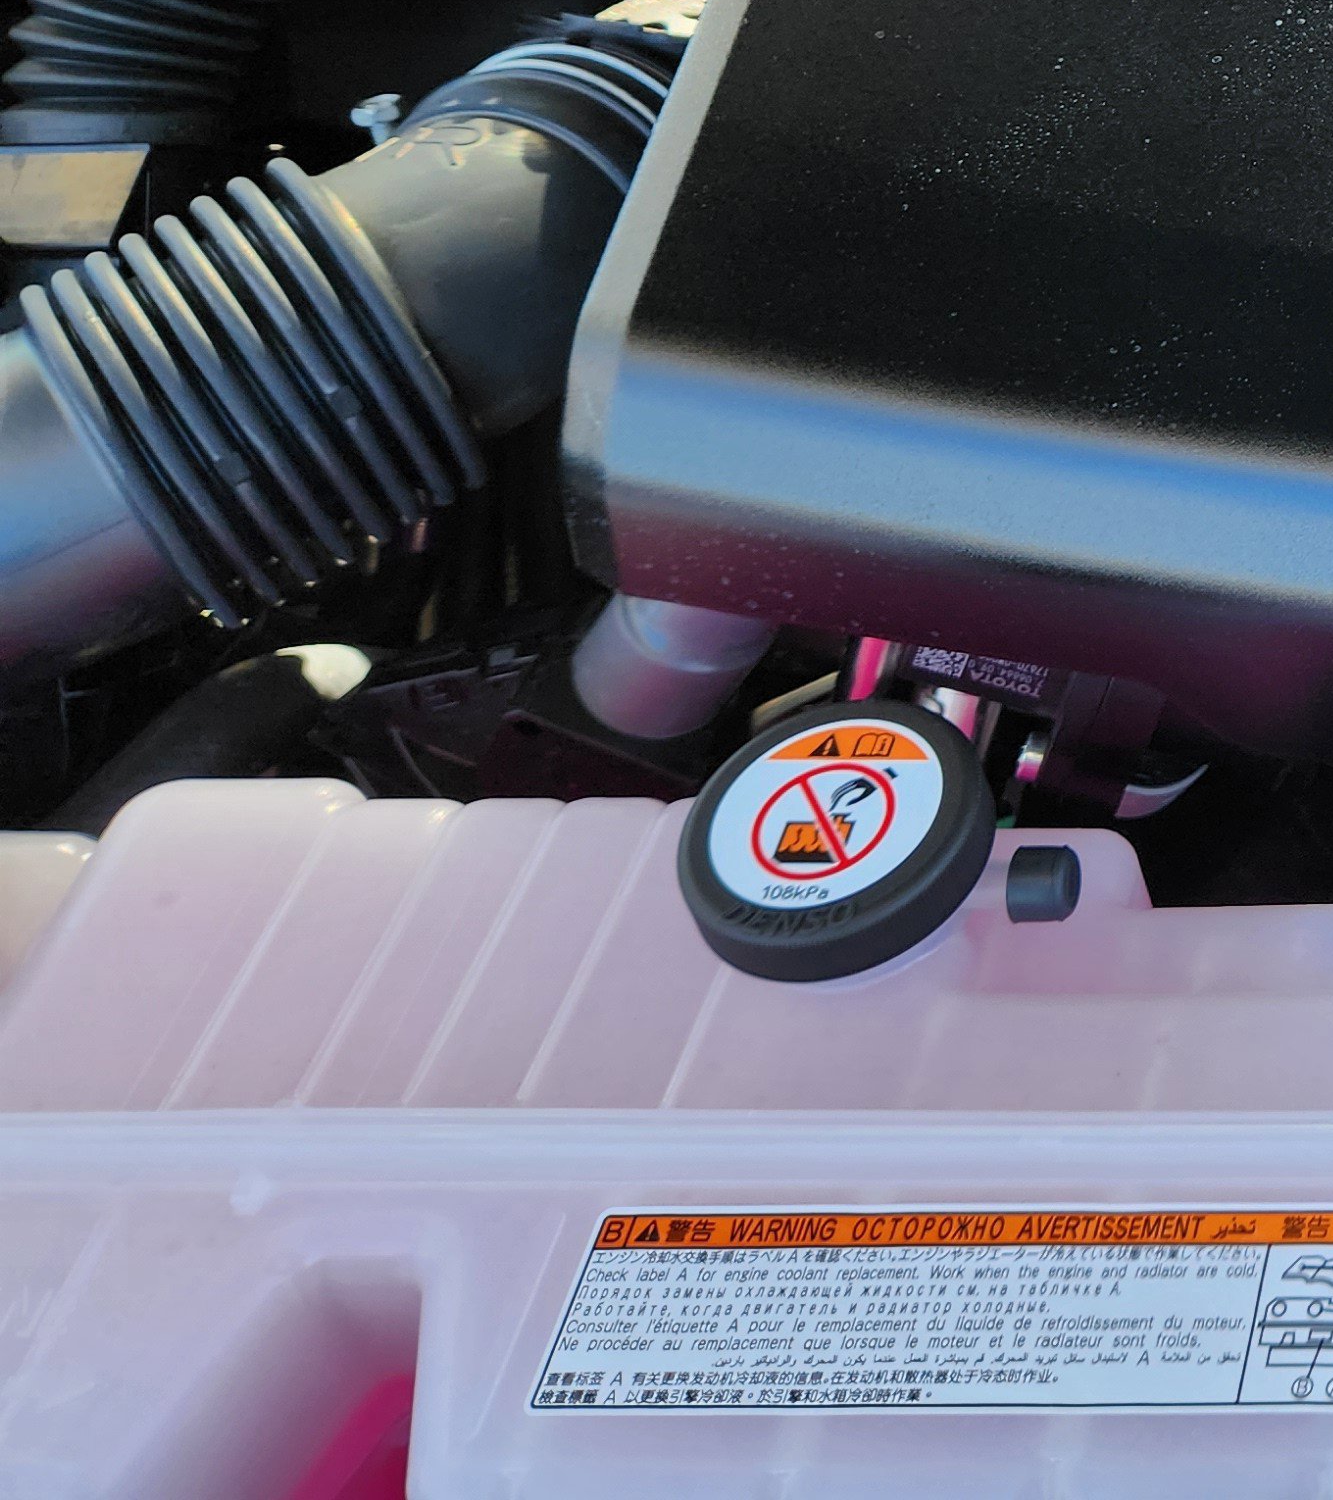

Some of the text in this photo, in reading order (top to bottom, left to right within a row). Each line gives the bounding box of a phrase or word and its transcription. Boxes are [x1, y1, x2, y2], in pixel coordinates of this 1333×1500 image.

[969, 669, 1041, 698] TOYOTA
[761, 884, 830, 900] 108kPa
[719, 900, 860, 937] DENSO
[602, 1220, 625, 1243] B
[665, 1219, 715, 1242] 警告
[729, 1218, 838, 1242] WARNING
[852, 1216, 1005, 1241] ОСТОРОЖНО
[1016, 1215, 1206, 1240] AVERTISSEMENT
[1210, 1218, 1256, 1240] تحذير
[1282, 1216, 1330, 1239] 警告
[586, 1263, 1258, 1284] Check label A for engine coolant replacement. Work when the engine and radiator are cold.
[579, 1285, 653, 1300] Порядок
[662, 1285, 726, 1299] замены
[735, 1282, 853, 1299] охлаждающей
[860, 1283, 947, 1298] жидкости
[988, 1282, 1008, 1296] на
[1018, 1281, 1102, 1296] табличке
[571, 1299, 1051, 1318] Работайте, когда двигатель и радиатор холодные.
[566, 1314, 1246, 1335] Consulter l'étiquette A pour le remplacement du liquide de refroidissement du moteur.
[558, 1332, 1201, 1352] Ne procéder au remplacement que lorsque le moteur et le radiateur sont froids.
[1136, 1350, 1150, 1366] A
[544, 1371, 606, 1386] 查看标签
[610, 1372, 624, 1386] A
[603, 1389, 617, 1404] A
